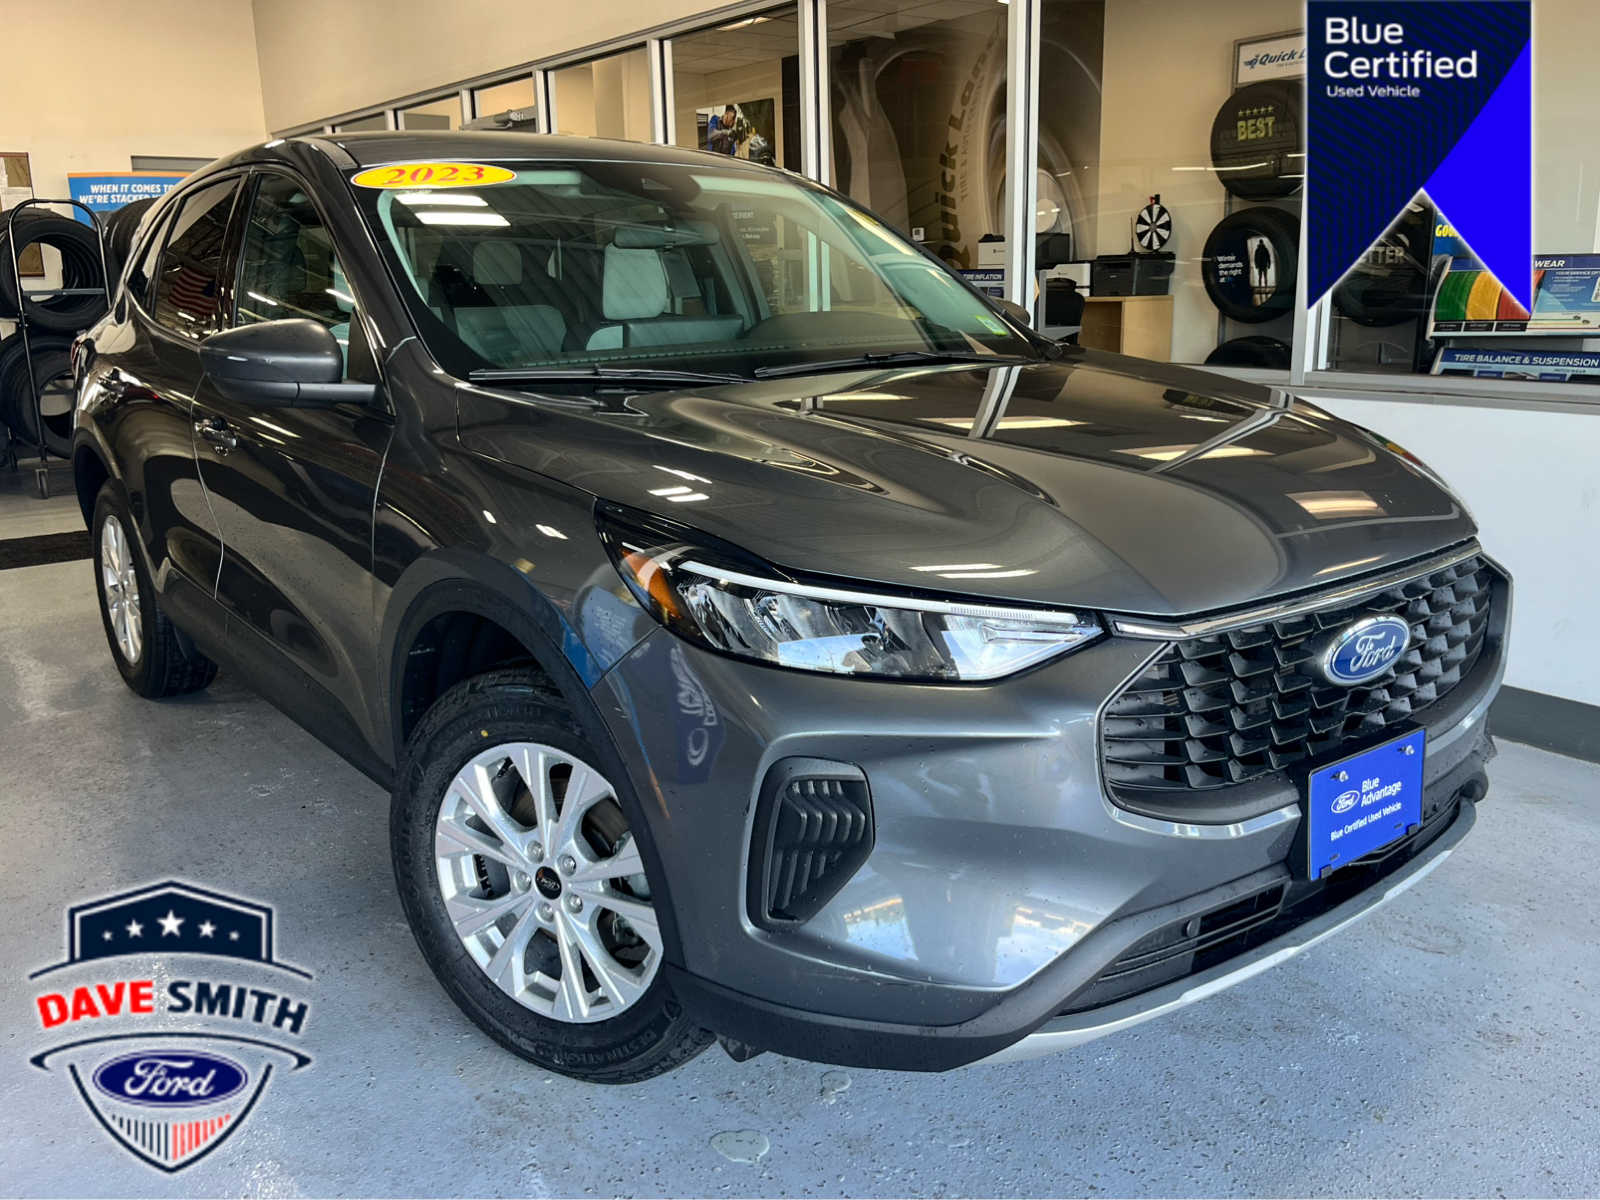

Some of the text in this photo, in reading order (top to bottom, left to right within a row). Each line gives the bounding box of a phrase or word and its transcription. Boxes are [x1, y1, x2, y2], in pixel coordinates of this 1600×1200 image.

[1259, 49, 1297, 66] Quick
[1236, 116, 1276, 141] BEST
[382, 166, 485, 185] 2023
[90, 184, 119, 193] WHEN
[121, 184, 128, 193] IT
[131, 184, 161, 193] COMES
[80, 195, 109, 204] WE'RE
[1360, 246, 1405, 264] TTER
[1535, 260, 1566, 268] WEAR
[1454, 354, 1475, 362] TIRE
[1476, 355, 1521, 363] BALANCE
[1532, 357, 1599, 367] SUSPENSION
[1350, 632, 1396, 672] Ford
[1362, 777, 1380, 793] Blue
[1336, 781, 1402, 810] Ford Advantage
[1330, 802, 1402, 841] Blue Certified Used Vehicle
